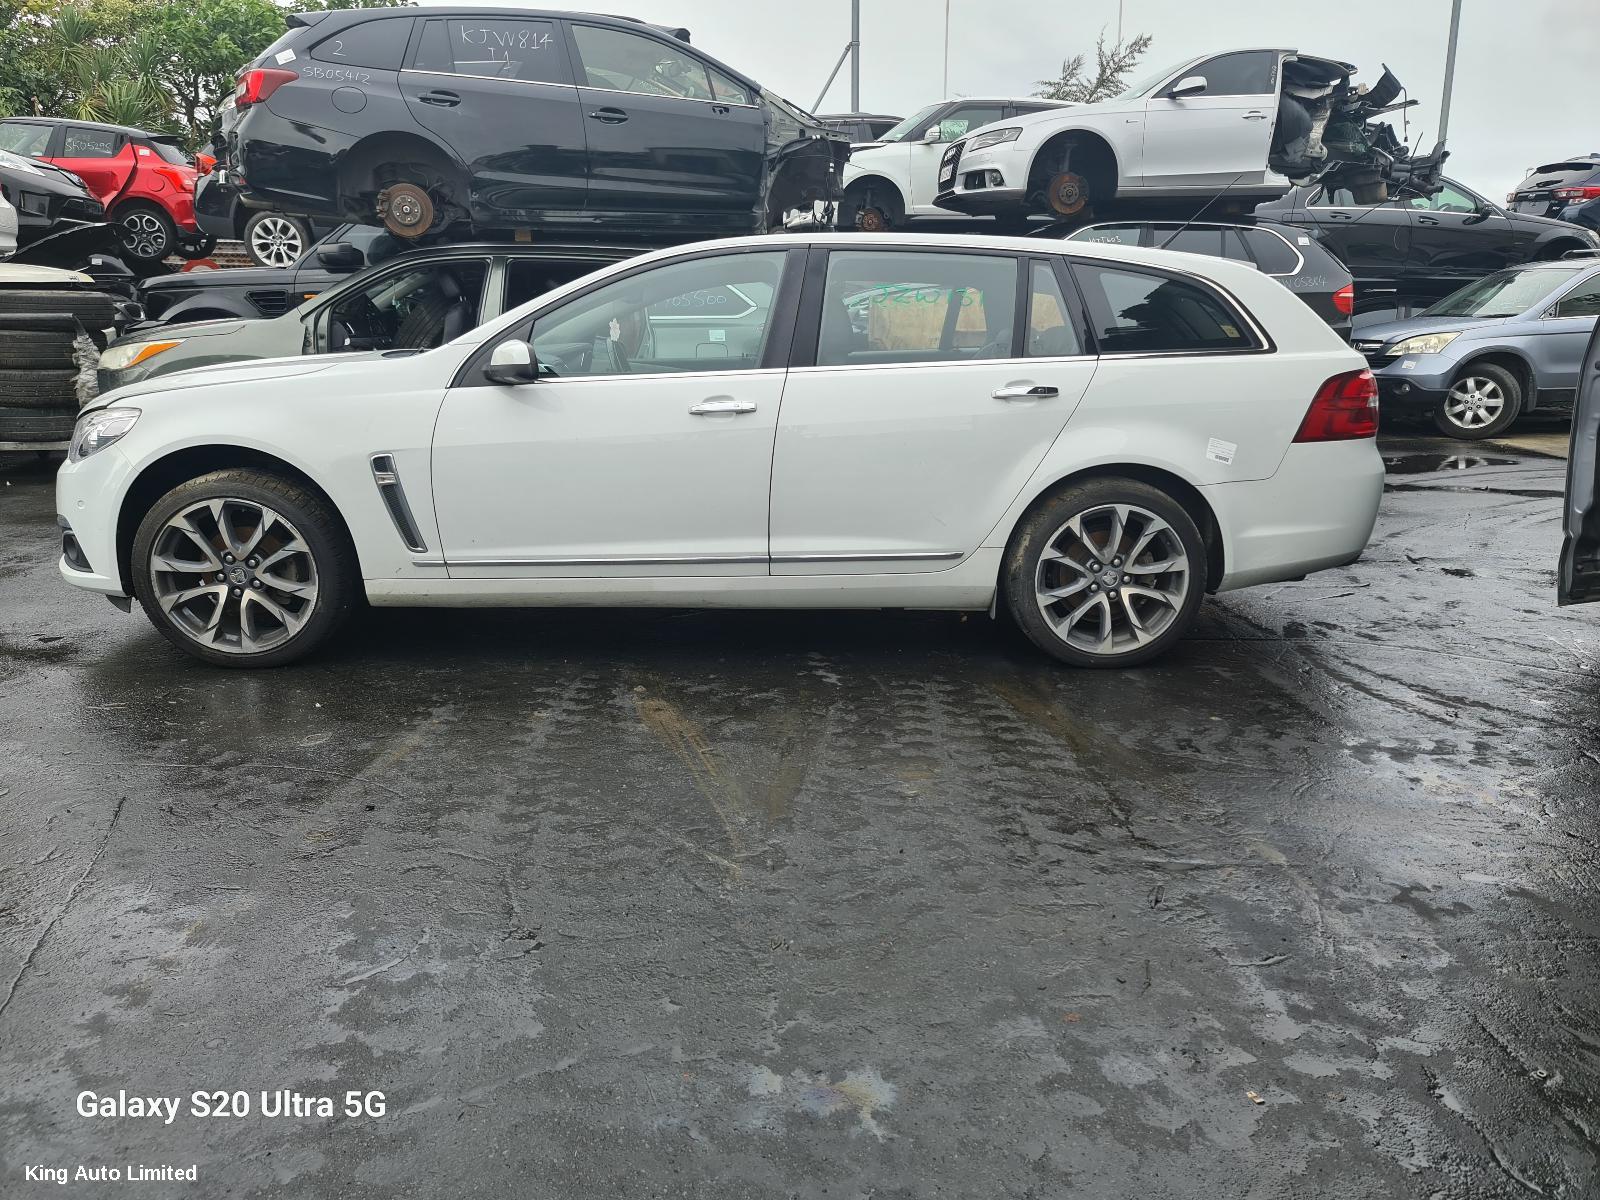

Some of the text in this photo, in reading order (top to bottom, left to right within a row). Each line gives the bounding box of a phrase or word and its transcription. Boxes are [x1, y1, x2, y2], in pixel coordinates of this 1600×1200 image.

[461, 25, 554, 50] KJW814
[332, 40, 347, 57] 2
[302, 66, 371, 86] SB05412
